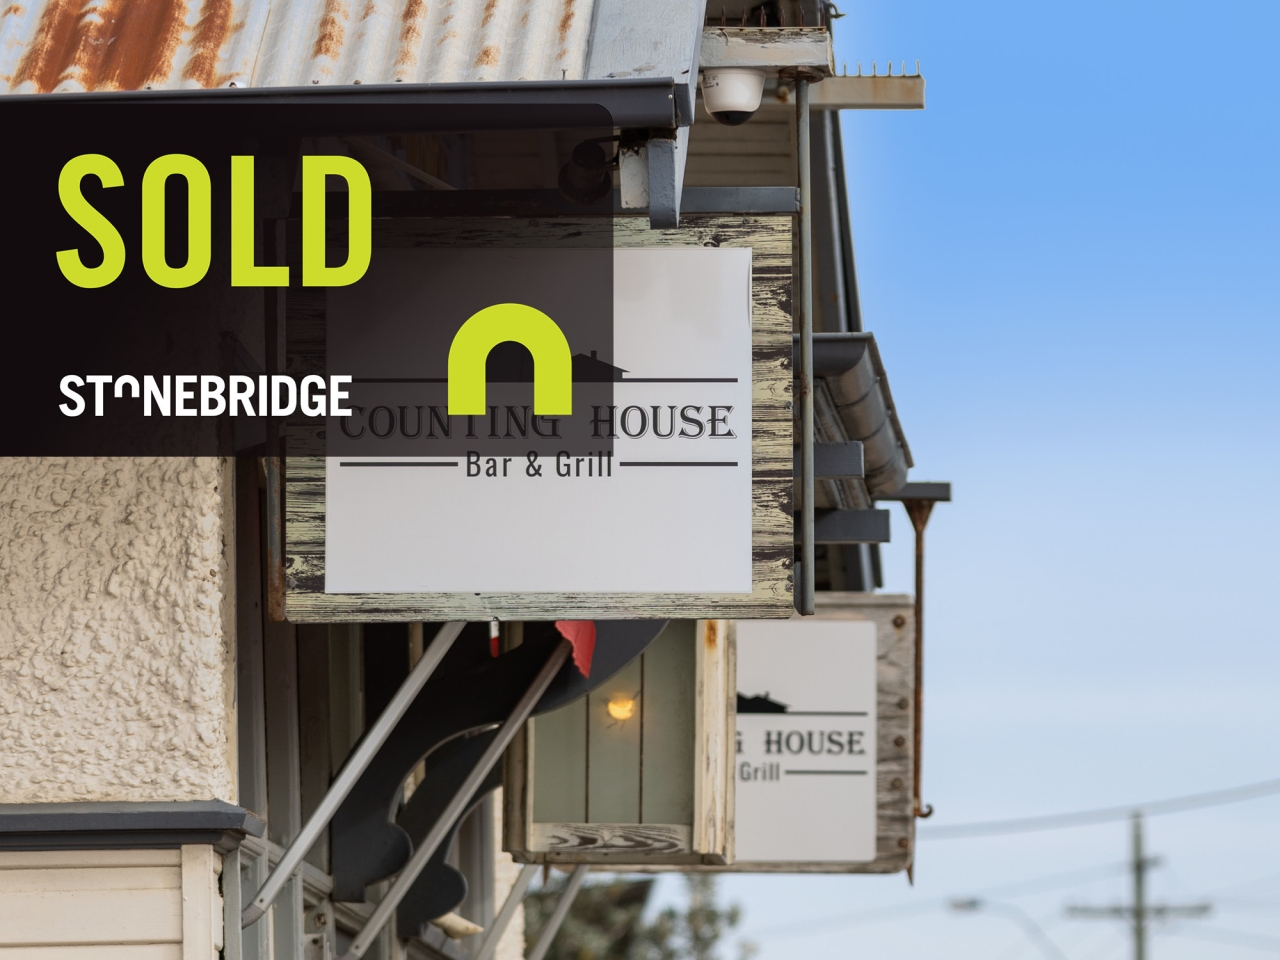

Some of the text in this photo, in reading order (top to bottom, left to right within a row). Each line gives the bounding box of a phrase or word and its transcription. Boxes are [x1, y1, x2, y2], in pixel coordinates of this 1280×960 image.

[590, 404, 738, 440] HOUSE
[466, 450, 612, 477] Bar & Grill
[765, 730, 866, 755] HOUSE
[739, 761, 780, 782] Grill
